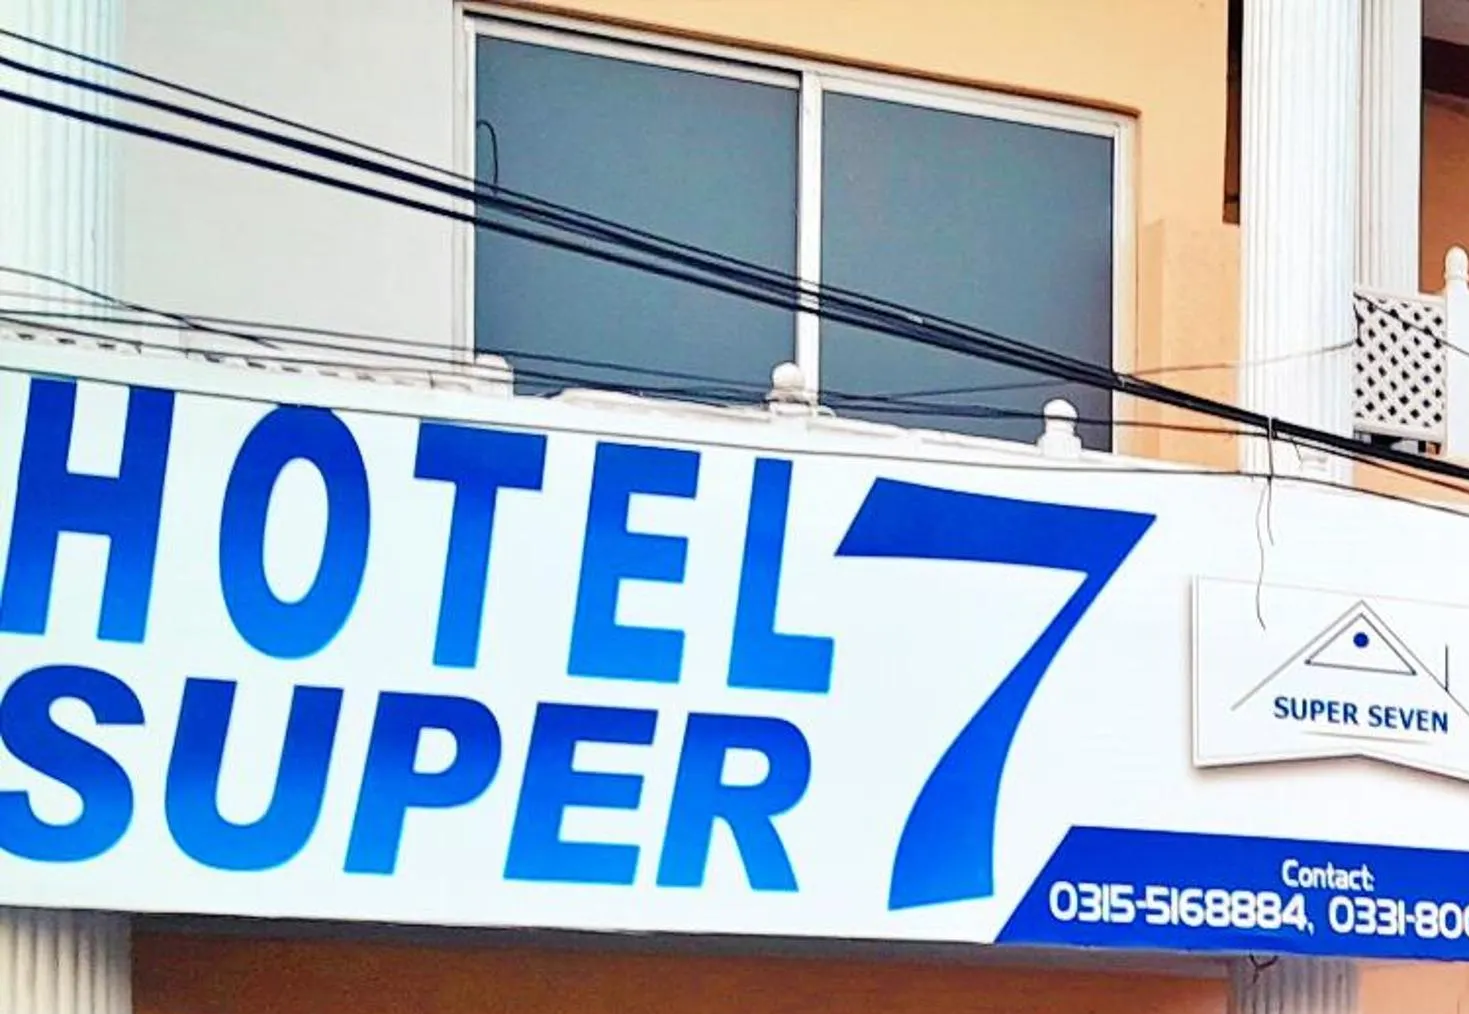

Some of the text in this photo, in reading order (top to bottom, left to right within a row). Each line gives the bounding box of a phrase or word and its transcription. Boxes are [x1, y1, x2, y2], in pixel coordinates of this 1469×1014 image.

[0, 376, 835, 694] HOTEL
[0, 664, 812, 893] SUPER
[834, 477, 1158, 911] 7
[1273, 696, 1449, 733] SUPER SEVEN
[1050, 881, 1315, 936] 0315-5168884,
